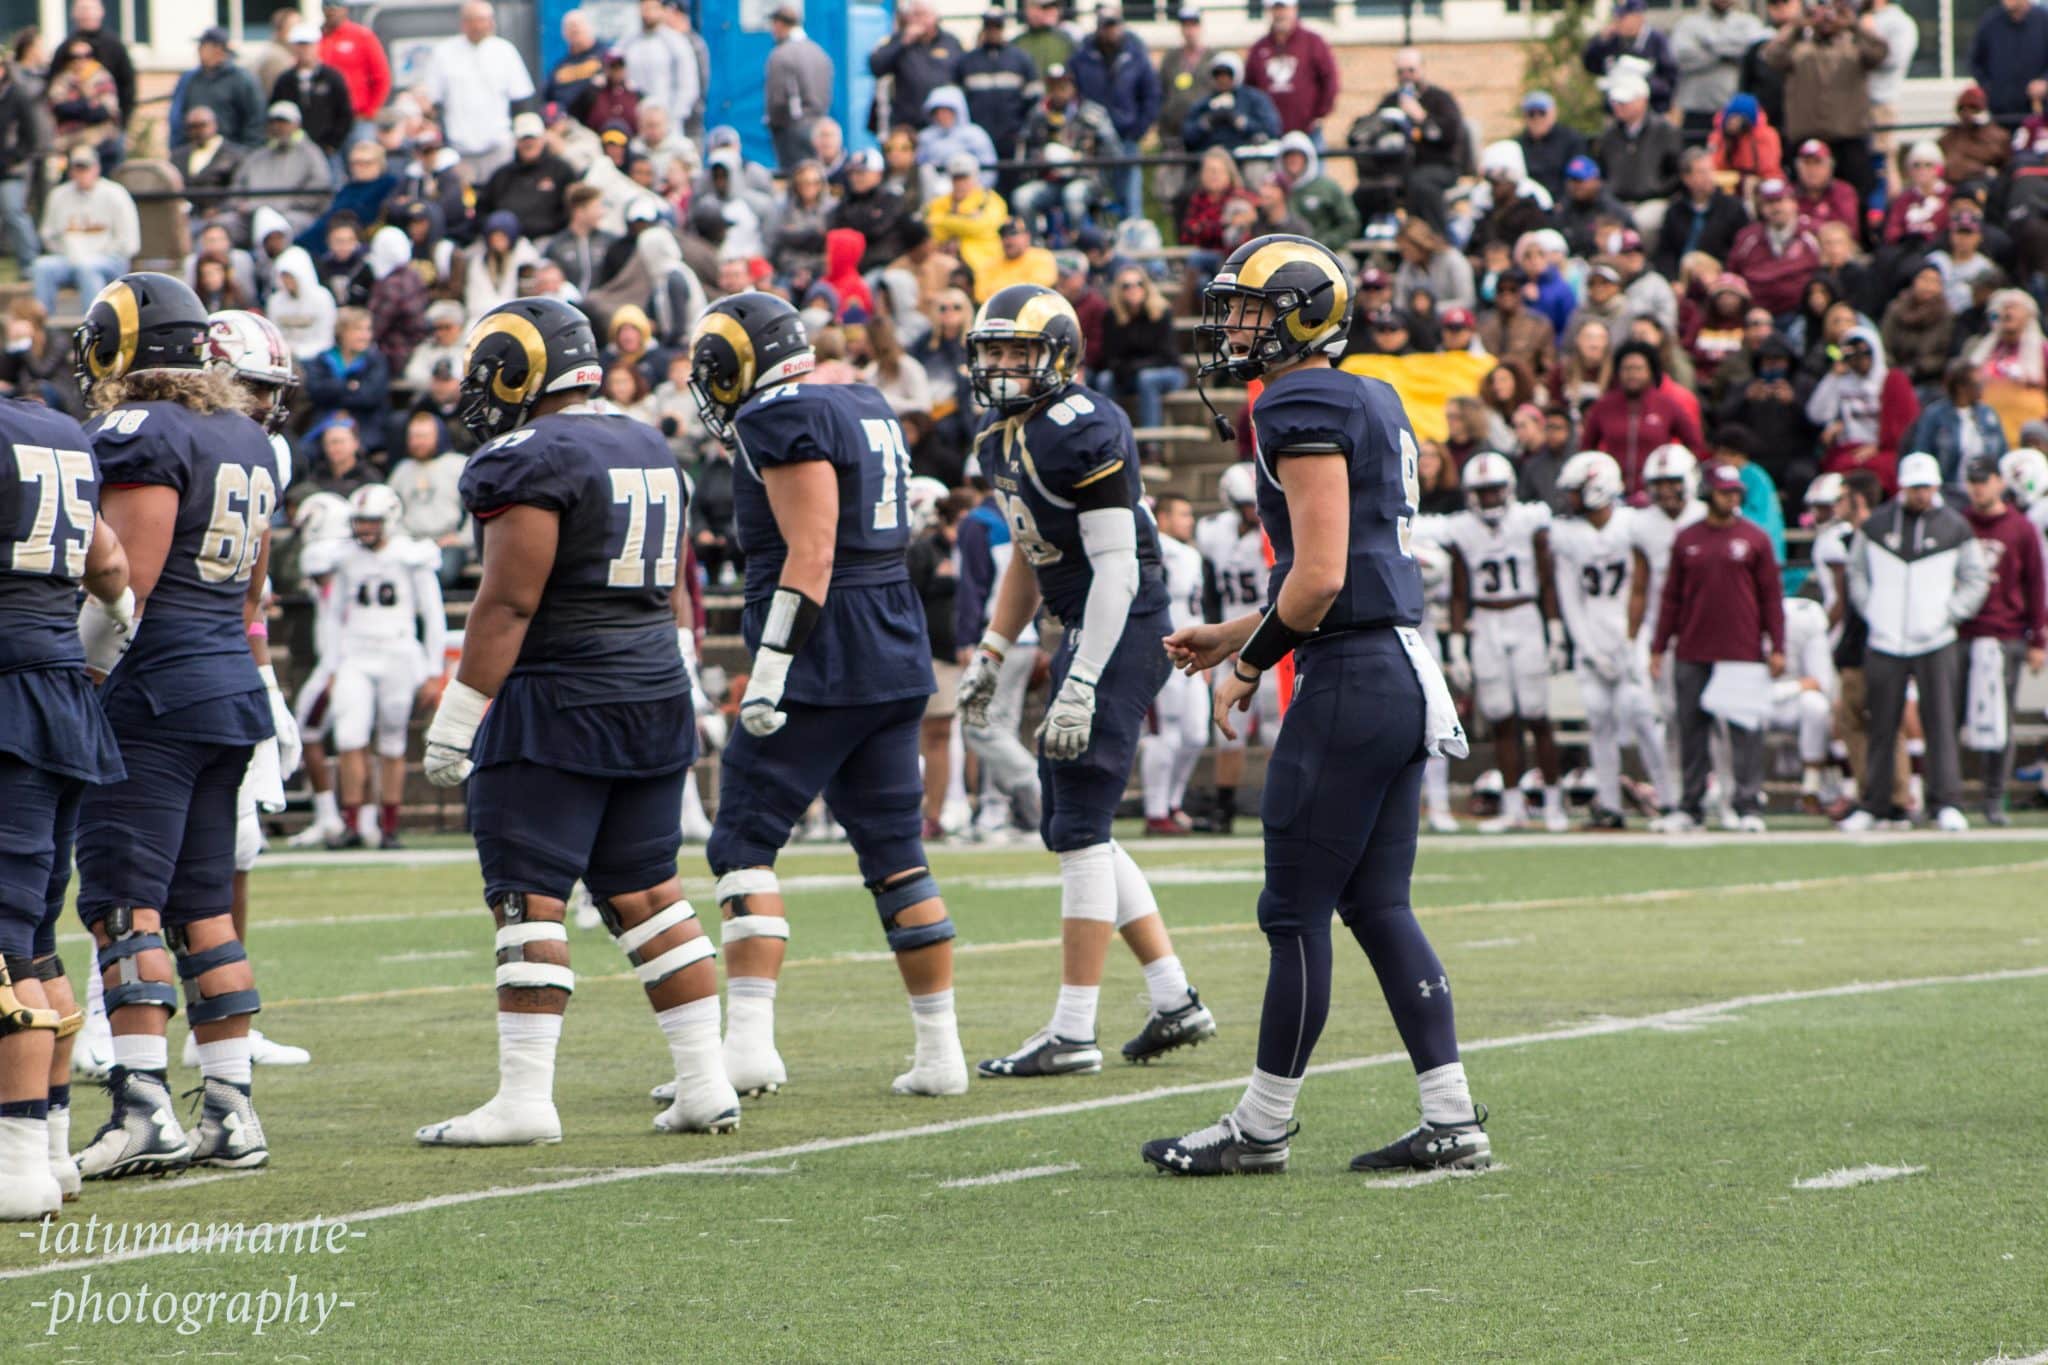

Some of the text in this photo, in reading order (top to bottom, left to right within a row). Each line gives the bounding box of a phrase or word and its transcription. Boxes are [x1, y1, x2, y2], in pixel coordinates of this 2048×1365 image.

[11, 444, 95, 577] 75
[195, 462, 277, 583] 68
[607, 467, 680, 587] 77
[1480, 556, 1519, 593] 31
[1582, 560, 1626, 596] 37
